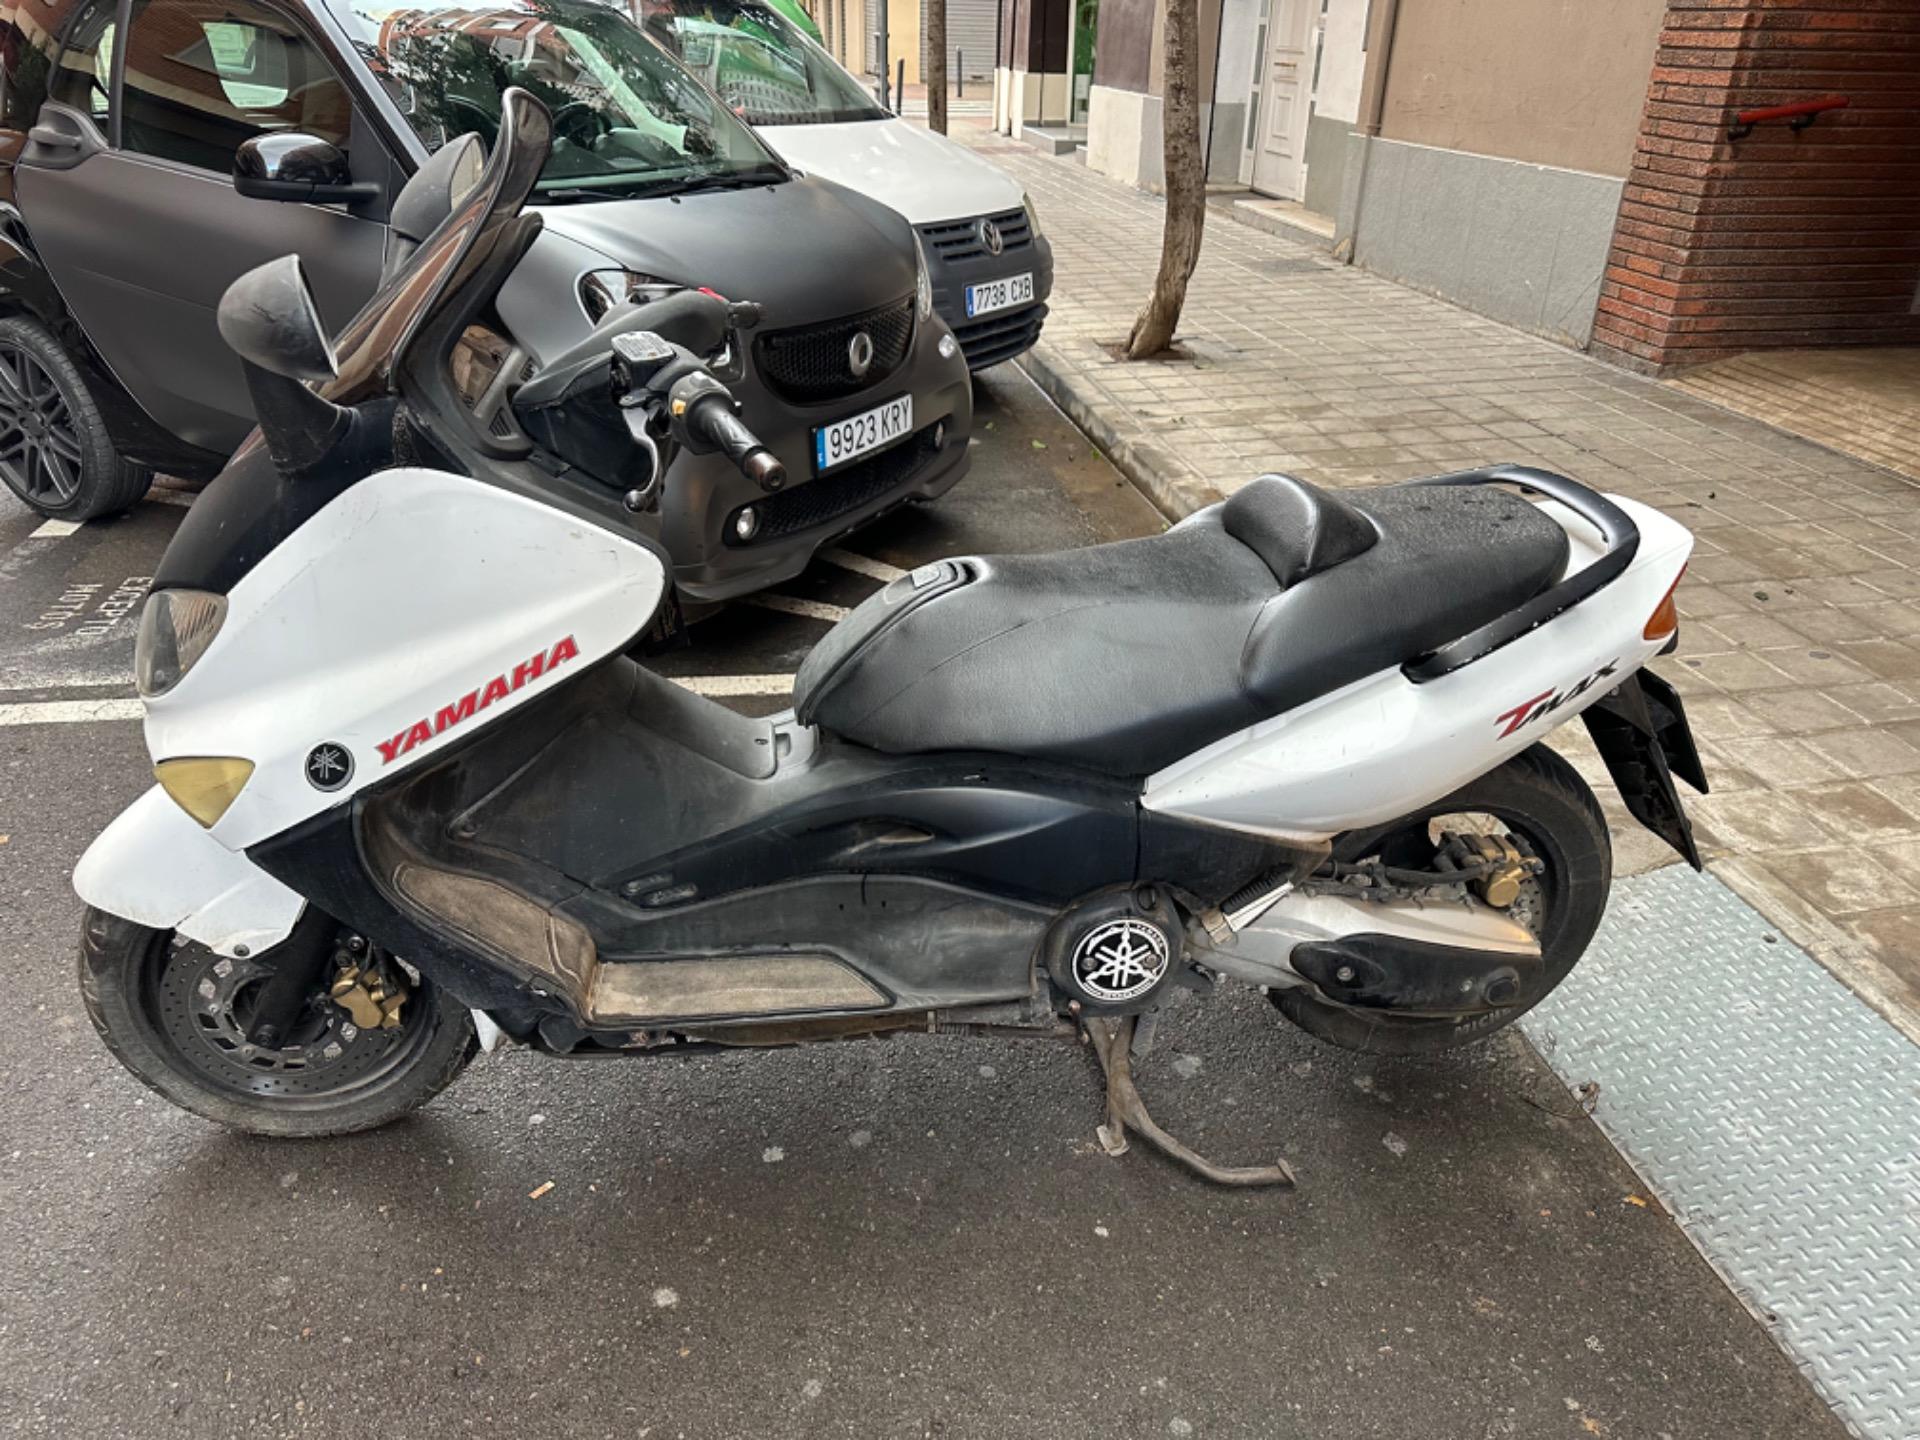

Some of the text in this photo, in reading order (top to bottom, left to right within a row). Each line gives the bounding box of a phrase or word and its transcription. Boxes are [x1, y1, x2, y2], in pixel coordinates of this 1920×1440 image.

[976, 283, 1007, 311] 7738
[830, 414, 876, 458] 9923
[881, 398, 911, 439] KRY
[374, 634, 580, 766] YAMAHA
